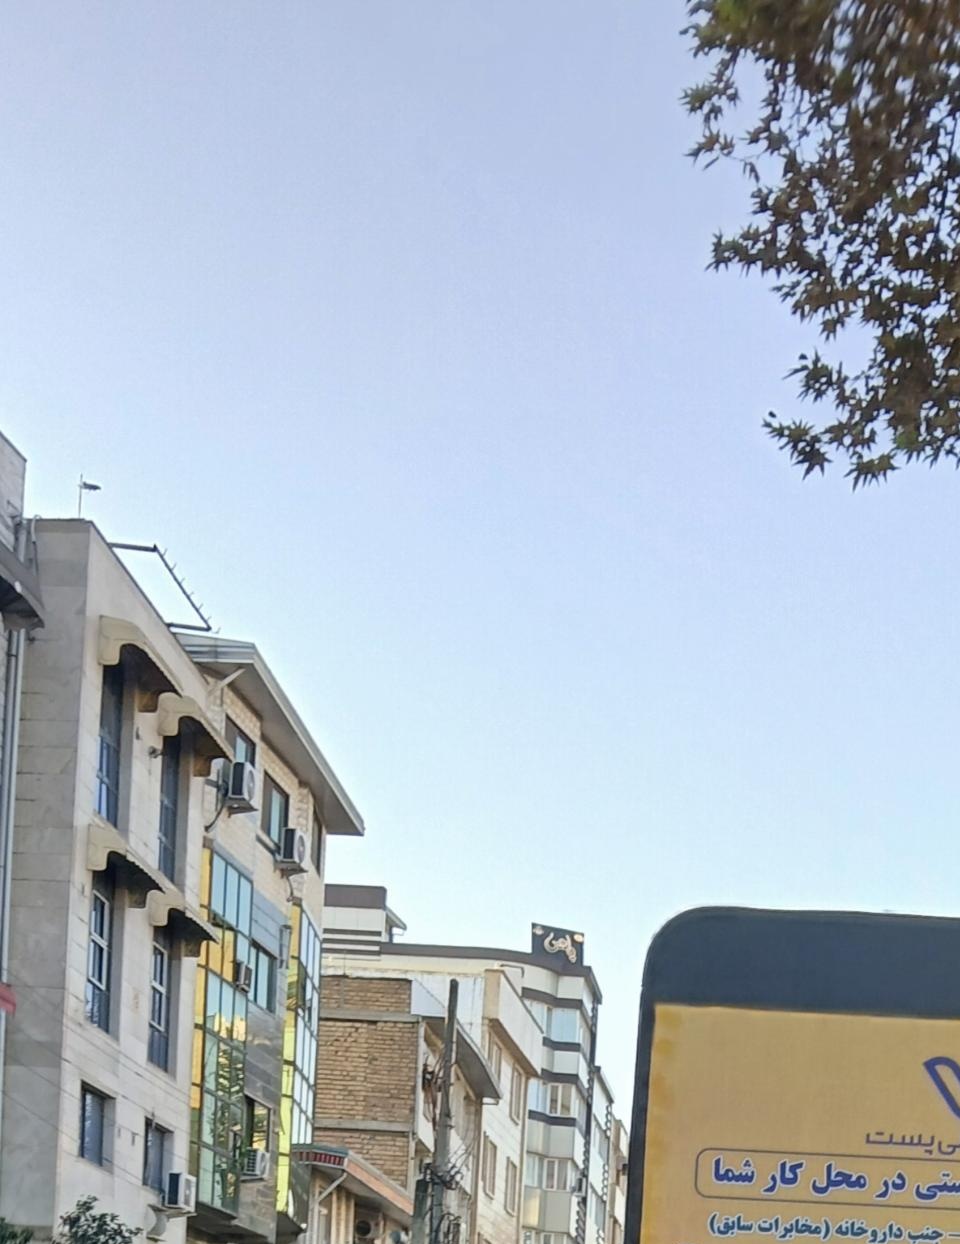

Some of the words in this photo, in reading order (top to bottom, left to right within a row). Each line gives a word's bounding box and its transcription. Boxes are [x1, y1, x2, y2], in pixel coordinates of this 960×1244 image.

[865, 1131, 935, 1155] پست
[713, 1157, 756, 1183] شما
[763, 1160, 803, 1194] کار
[811, 1163, 867, 1195] محل
[875, 1171, 906, 1199] در
[835, 1219, 903, 1243] داروخانه
